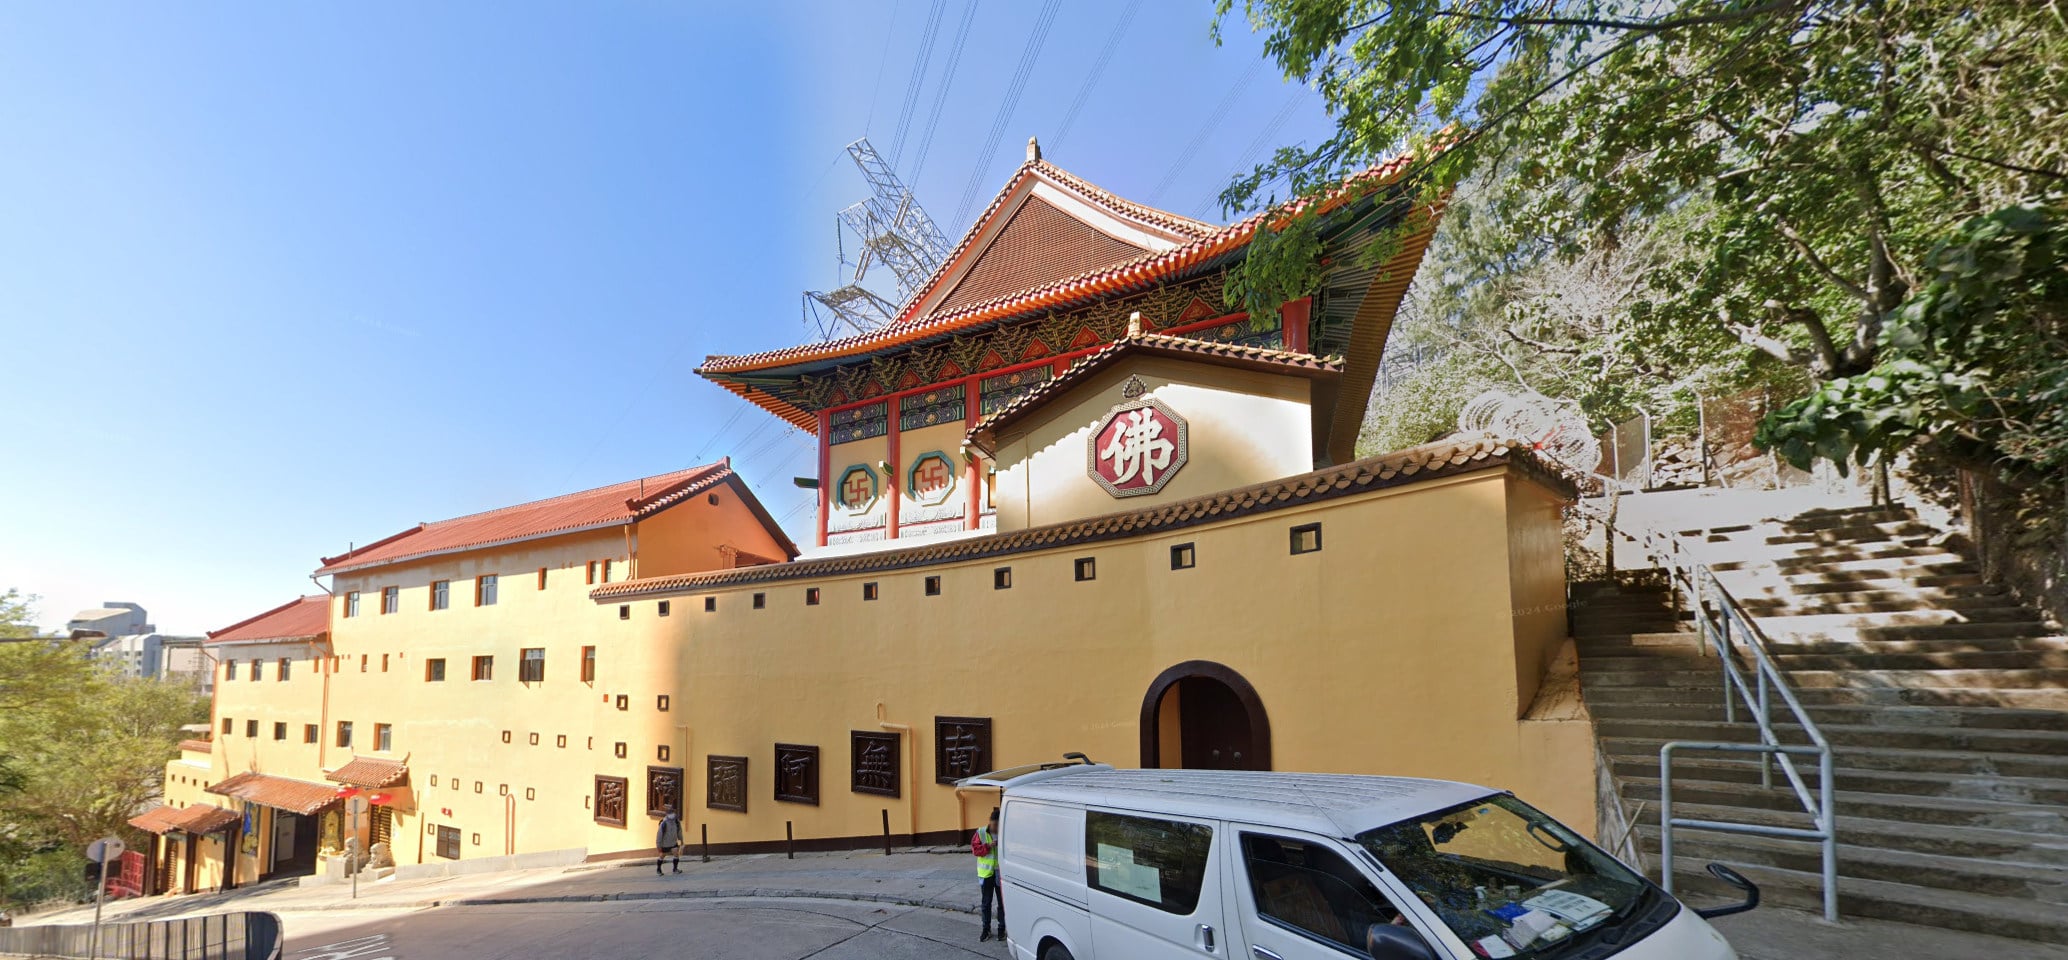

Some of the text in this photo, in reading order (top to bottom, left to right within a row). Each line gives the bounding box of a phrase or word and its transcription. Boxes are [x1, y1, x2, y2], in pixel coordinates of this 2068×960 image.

[1101, 408, 1174, 485] 佛
[856, 741, 892, 788] 無
[945, 725, 981, 778] 南
